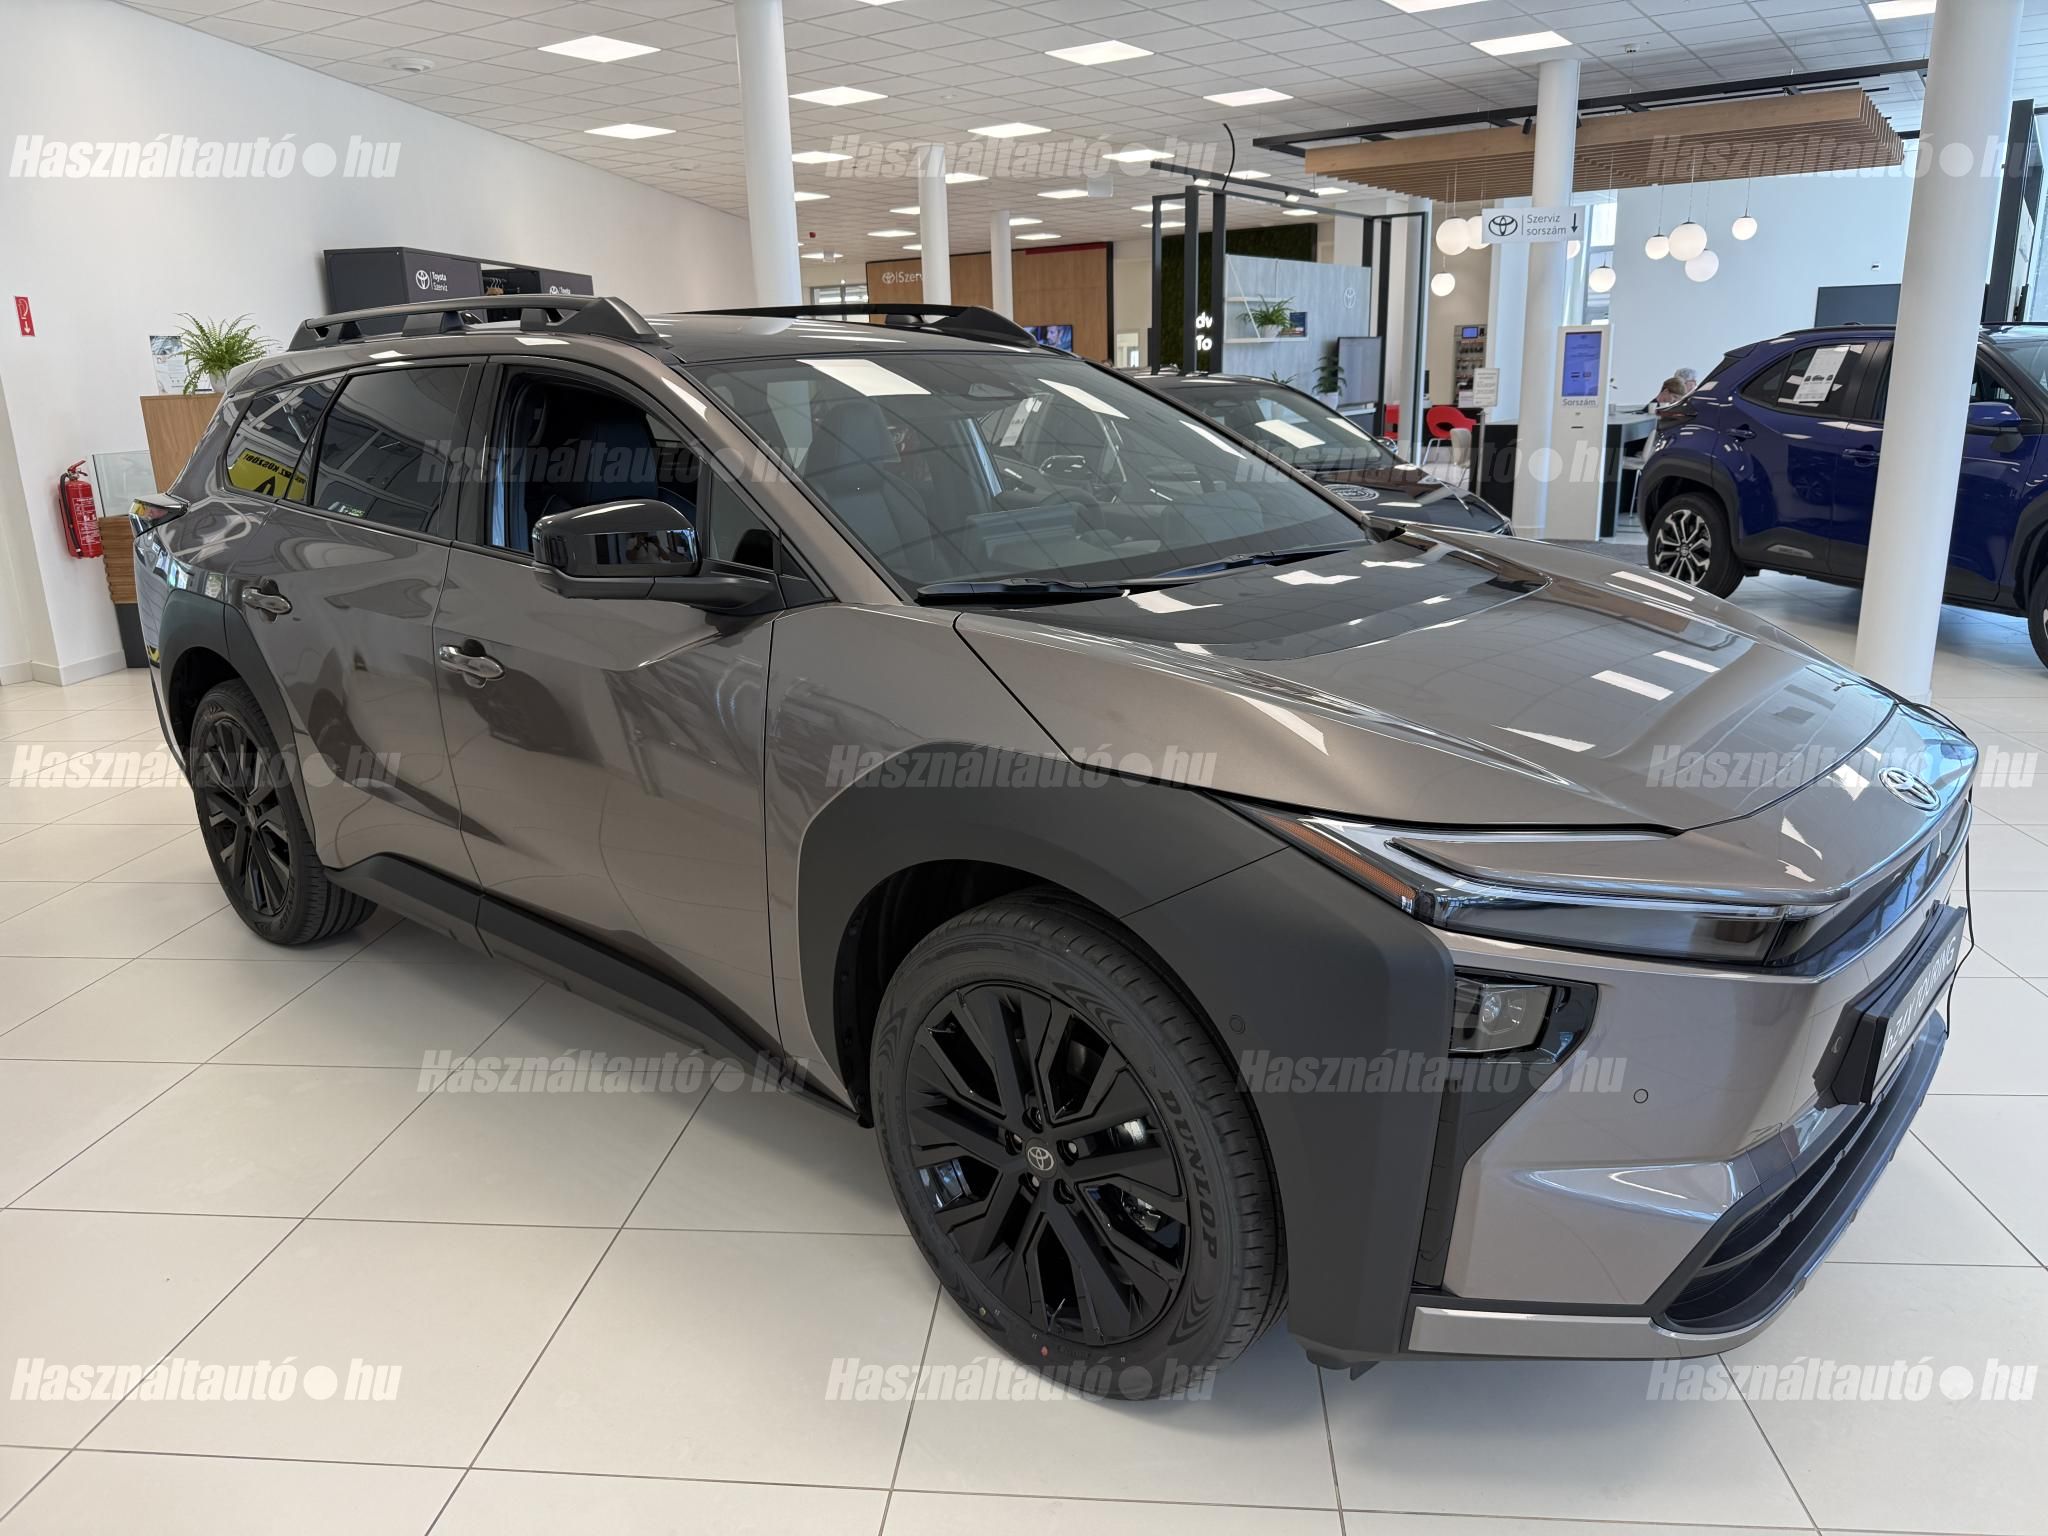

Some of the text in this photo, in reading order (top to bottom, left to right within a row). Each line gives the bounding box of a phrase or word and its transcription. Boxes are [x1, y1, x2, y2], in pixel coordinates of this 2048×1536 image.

[1527, 214, 1561, 224] Szerviz
[1526, 226, 1567, 236] sorszám
[432, 271, 447, 282] Toyota
[1562, 398, 1597, 407] Sorszám
[1158, 1088, 1218, 1260] DUNLOP
